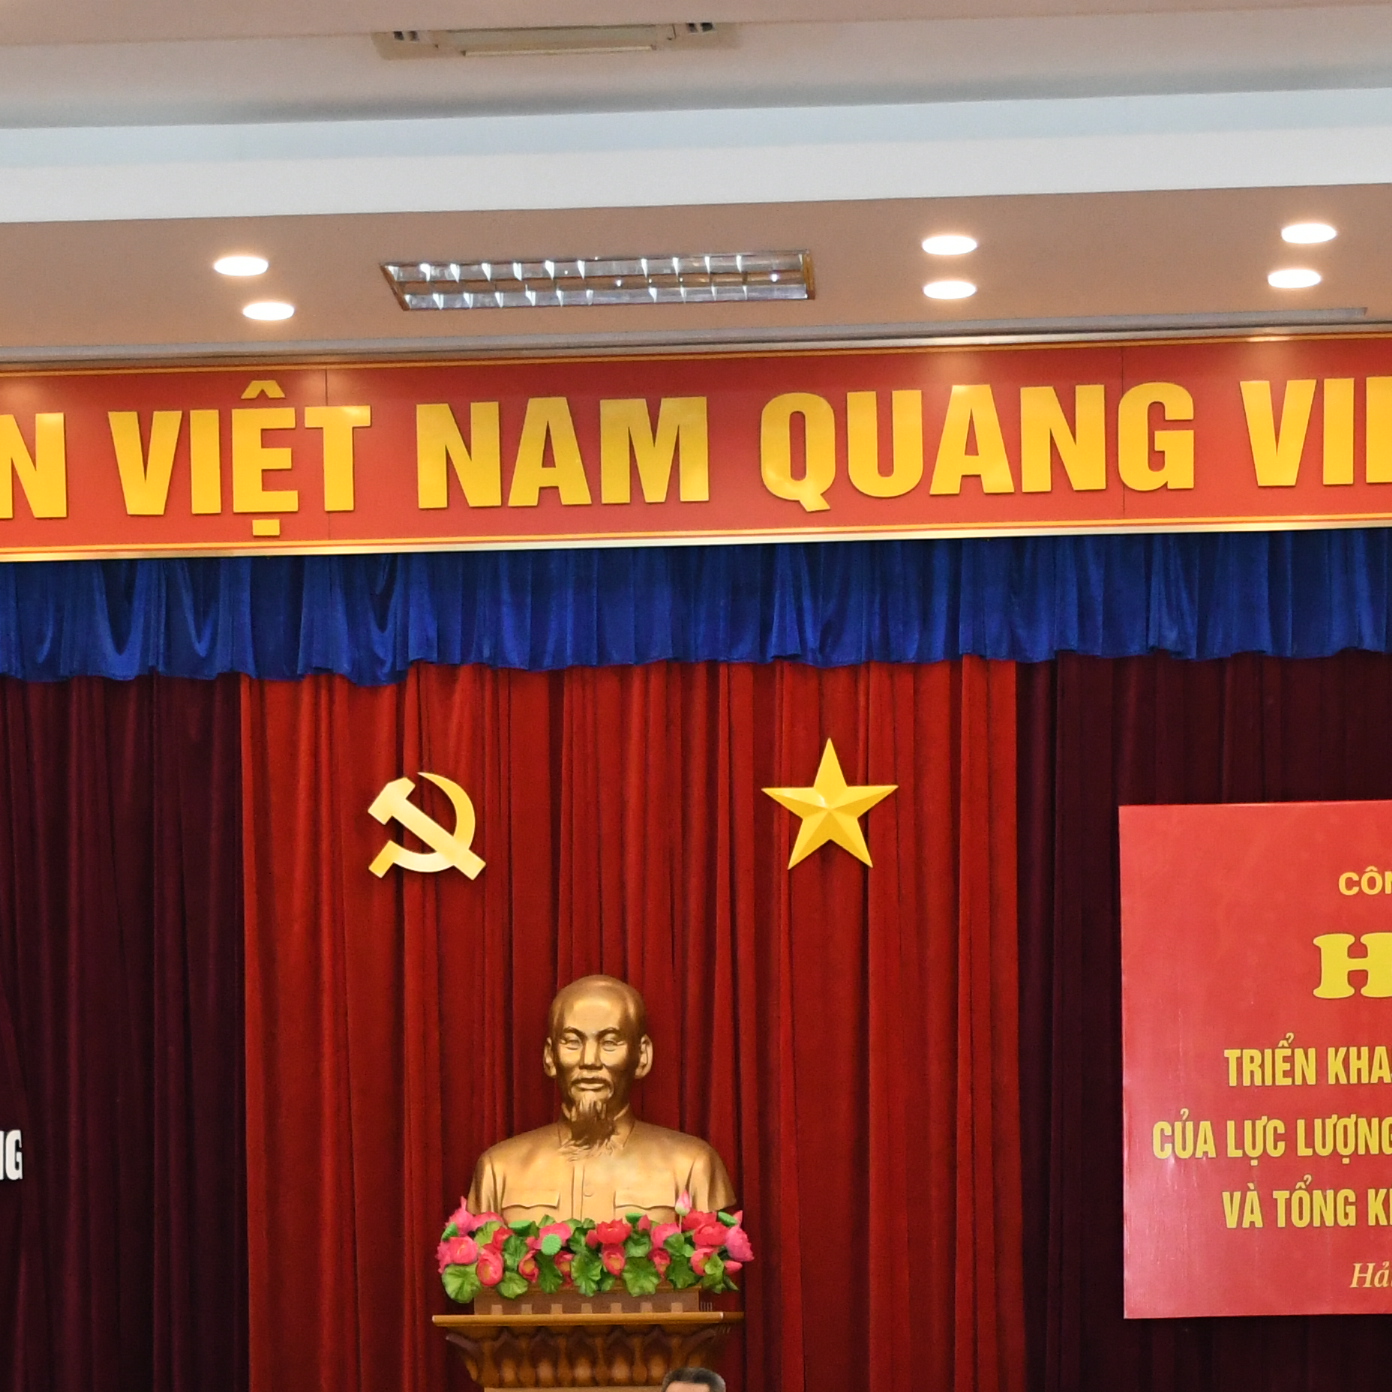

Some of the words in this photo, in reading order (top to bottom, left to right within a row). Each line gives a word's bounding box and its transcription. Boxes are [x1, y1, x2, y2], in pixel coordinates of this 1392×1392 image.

[107, 379, 372, 537] VIỆT
[414, 396, 710, 508] NAM
[760, 384, 1196, 513] QUANG
[1223, 1032, 1317, 1087] TRIỂN
[1151, 1107, 1217, 1160] CỦA
[1226, 1115, 1286, 1163] LỰC
[1221, 1182, 1264, 1229] VÀ
[1272, 1173, 1357, 1228] TỔNG
